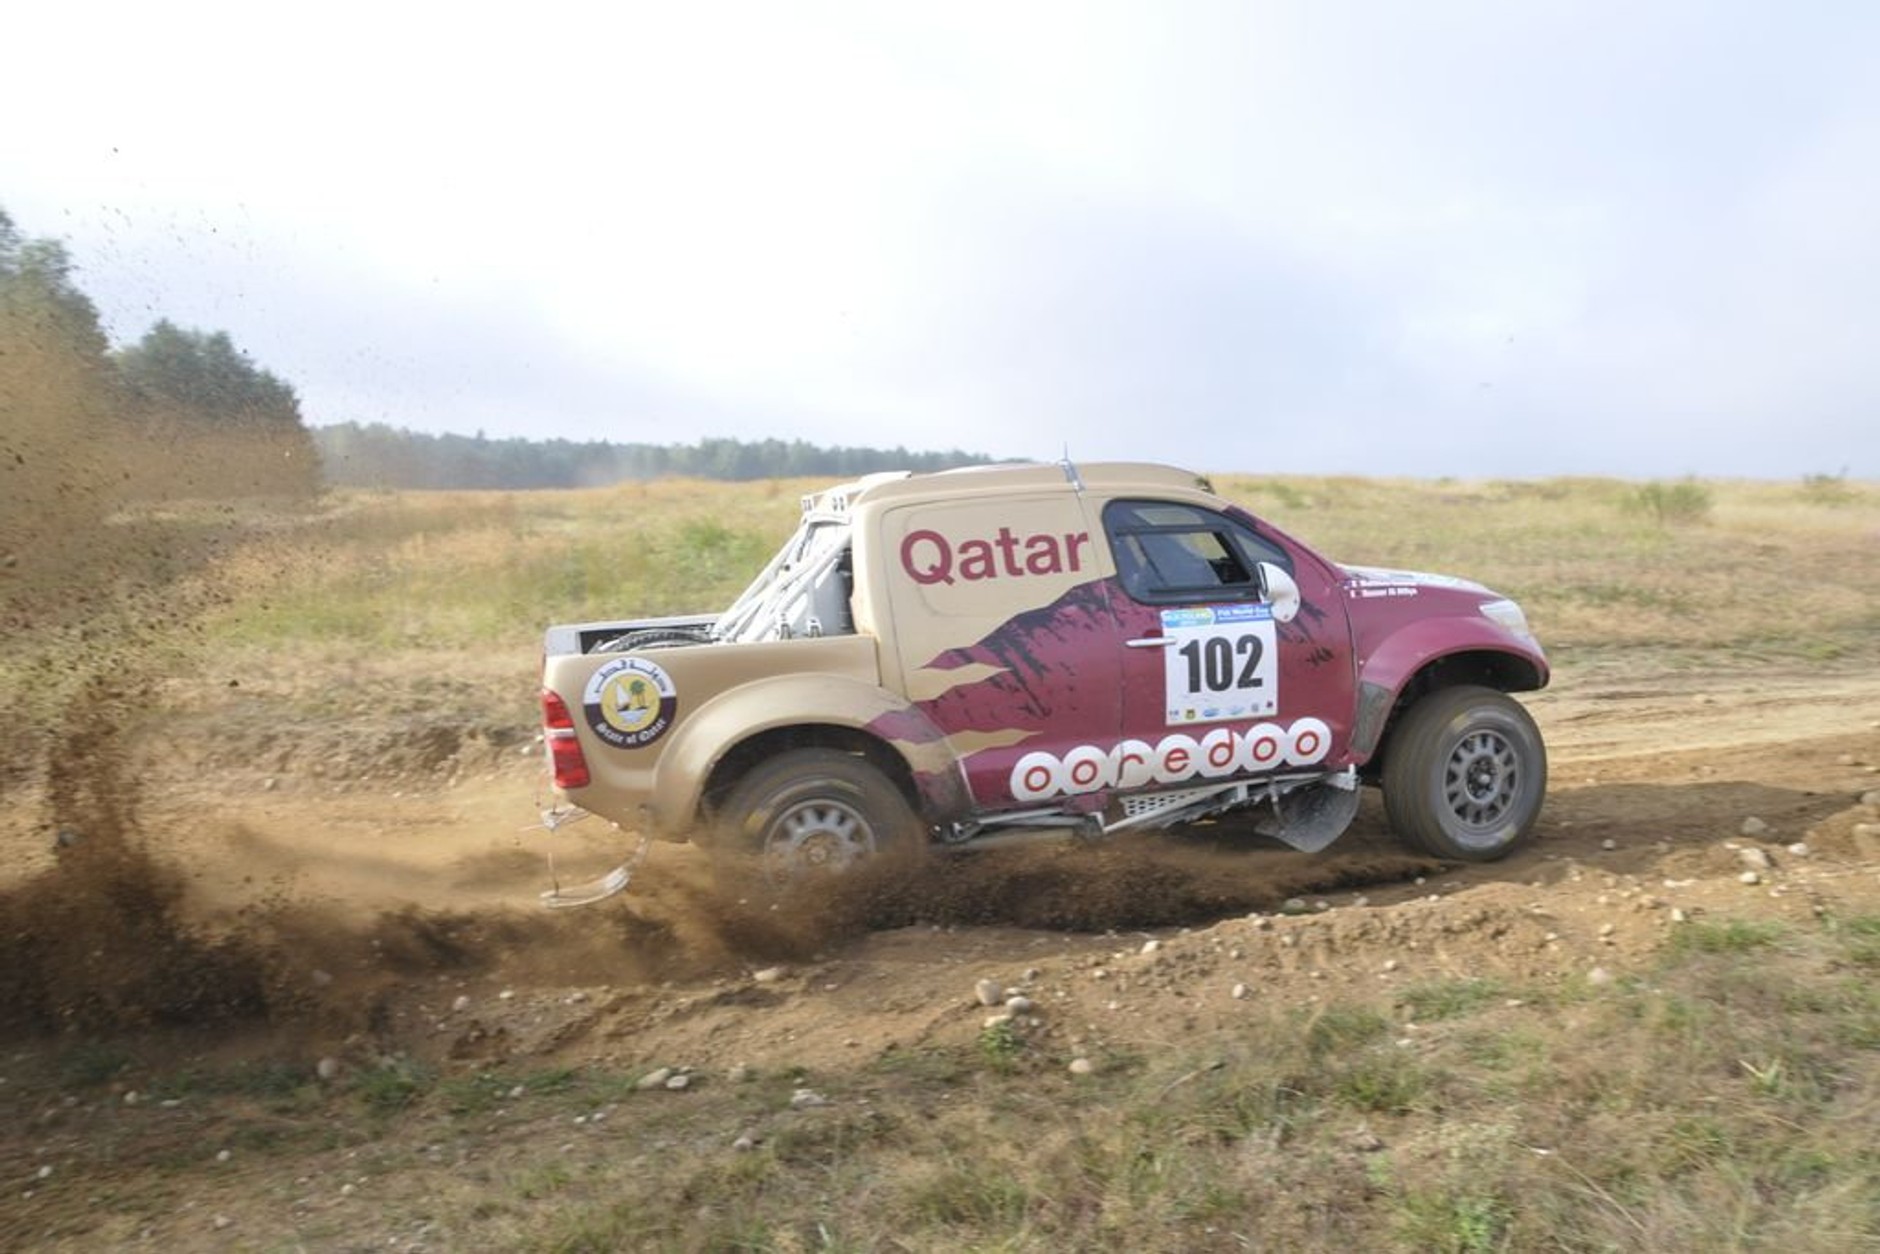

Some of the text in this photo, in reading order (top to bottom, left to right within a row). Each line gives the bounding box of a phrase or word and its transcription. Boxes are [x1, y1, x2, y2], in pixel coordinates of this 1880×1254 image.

[901, 527, 1089, 586] Qatar
[1179, 634, 1263, 694] 102
[1023, 730, 1320, 792] ooredoo
